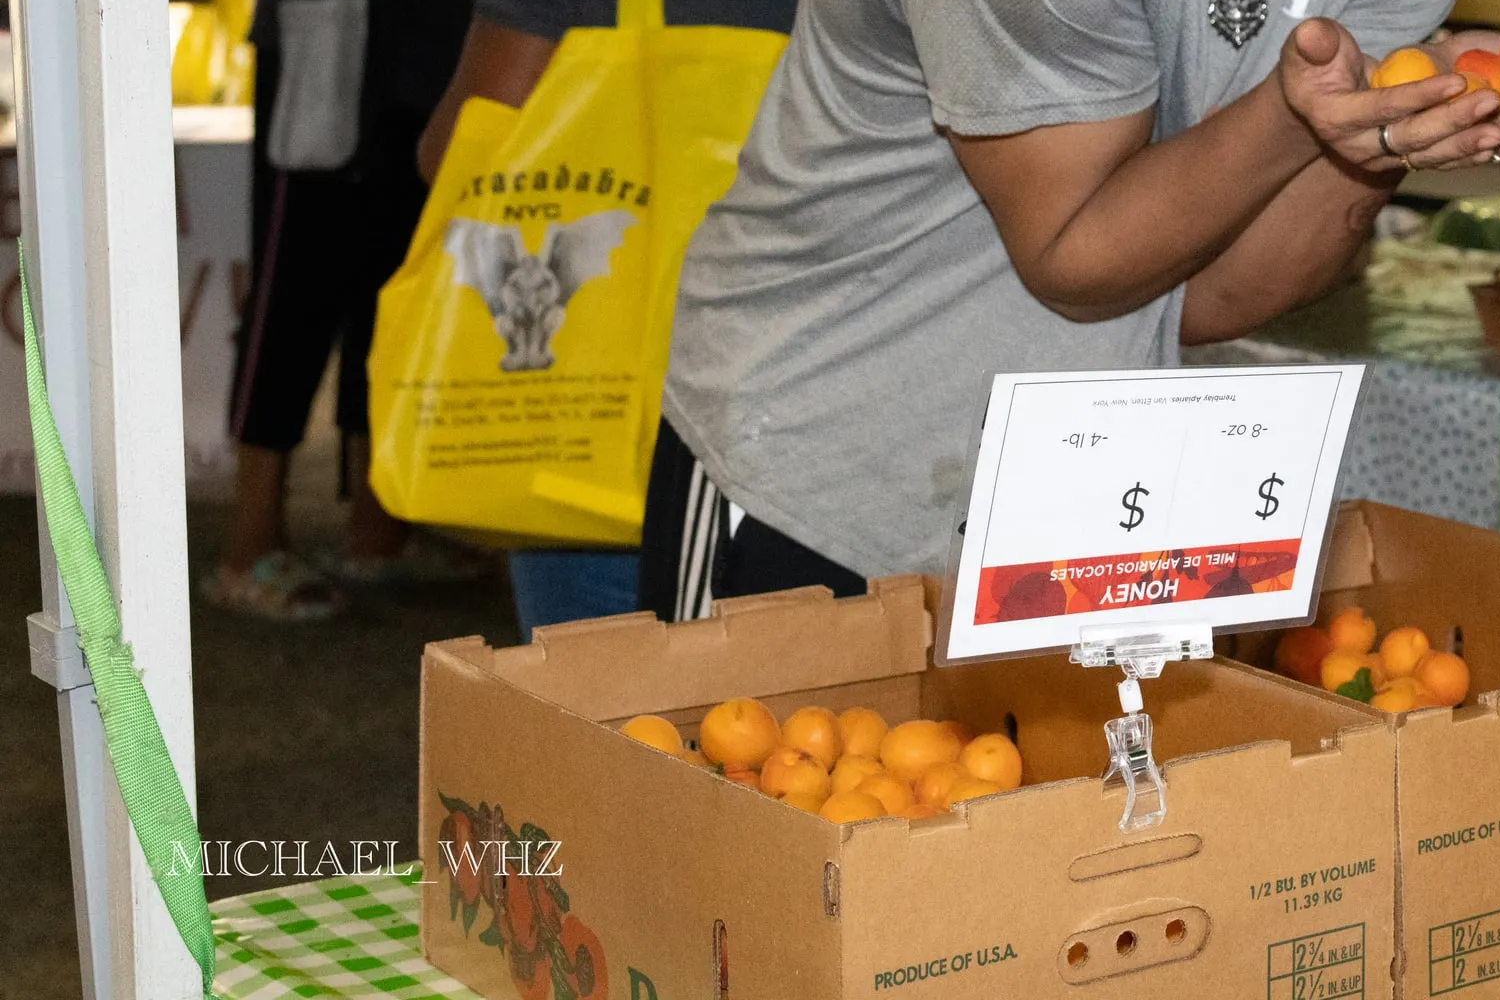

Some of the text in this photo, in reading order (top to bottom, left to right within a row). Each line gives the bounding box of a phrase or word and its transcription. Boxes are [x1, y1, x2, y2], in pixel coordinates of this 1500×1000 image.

[460, 162, 652, 208] racadabra
[503, 203, 561, 220] NYC
[1092, 399, 1111, 407] York
[1113, 398, 1128, 406] New
[1152, 396, 1167, 405] Van
[1203, 394, 1236, 403] Tremblay
[1119, 481, 1150, 532] $
[1254, 472, 1285, 520] $
[1050, 552, 1235, 581] MIEL DE APIARIOS LOCALES
[1099, 578, 1180, 604] HONEY
[1417, 827, 1476, 855] PRODUCE
[1478, 822, 1496, 839] OF
[1250, 859, 1376, 900] 1/2 BU. BY VOLUME
[1284, 888, 1343, 913] 11.39 KG
[1349, 943, 1361, 958] UP
[875, 958, 948, 991] PRODUCE
[951, 952, 972, 973] OF
[1349, 975, 1361, 990] UP
[1456, 958, 1465, 984] 2
